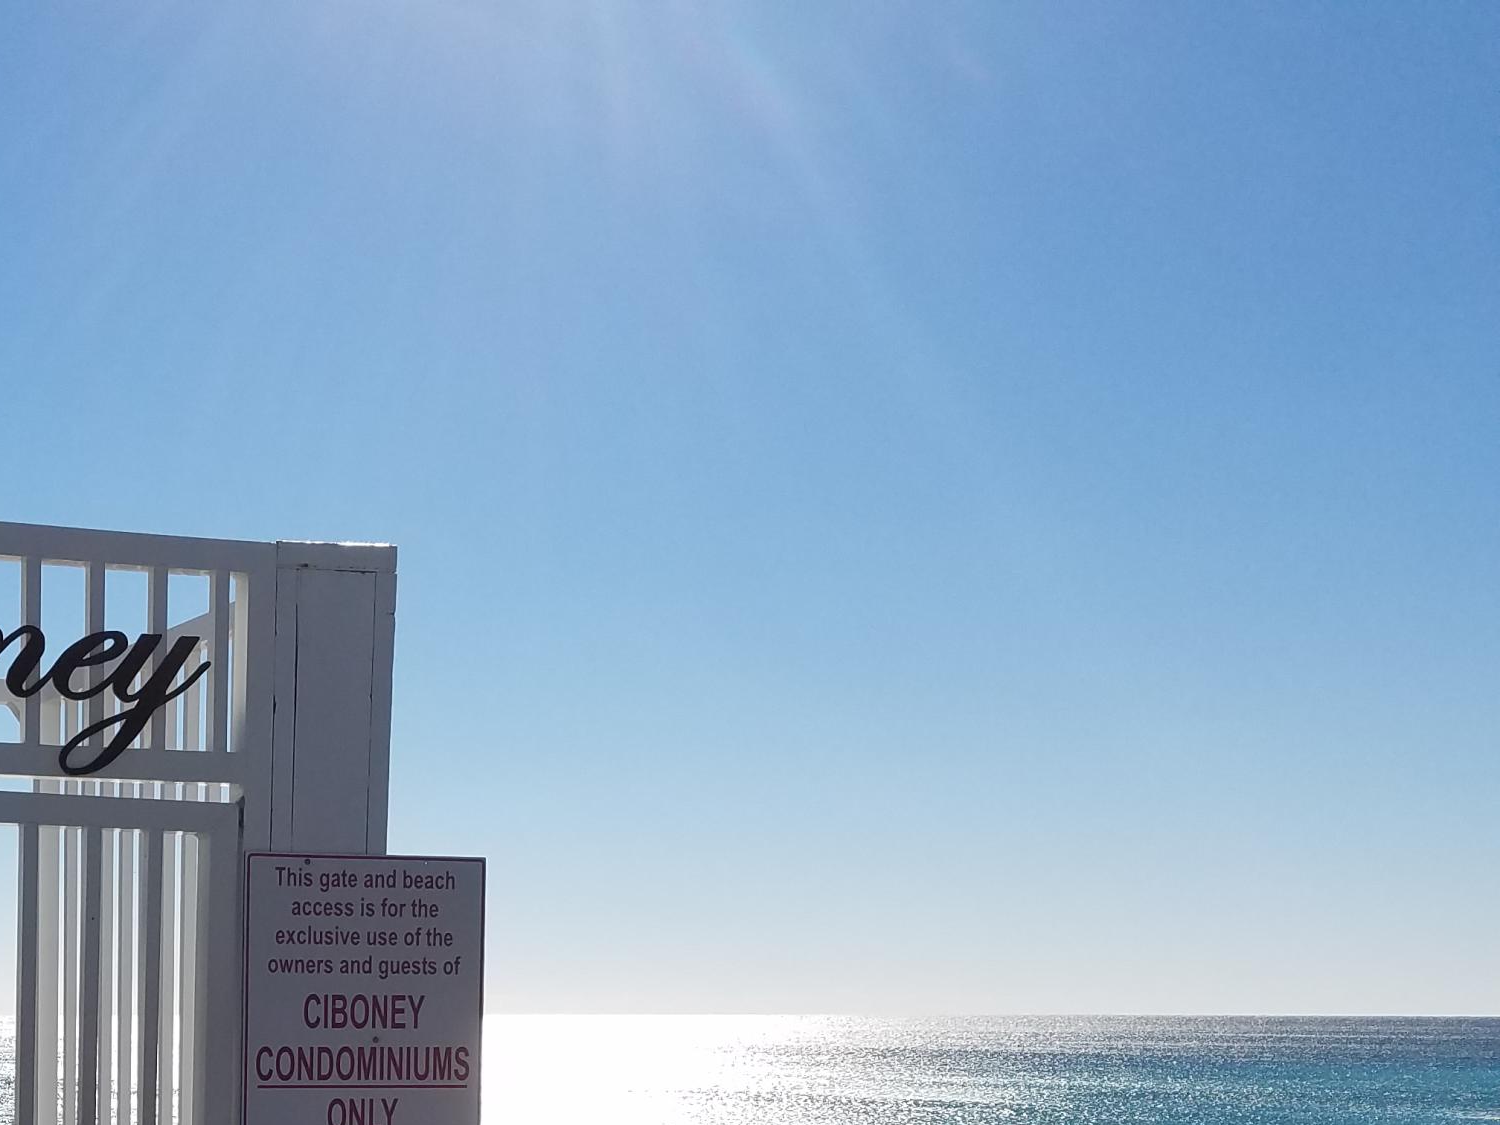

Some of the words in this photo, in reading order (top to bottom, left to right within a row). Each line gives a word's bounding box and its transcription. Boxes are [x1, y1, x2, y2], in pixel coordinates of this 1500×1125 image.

[275, 867, 313, 888] This
[320, 869, 357, 892] gate
[364, 869, 396, 889] and
[403, 869, 455, 890] beach
[291, 899, 354, 916] access
[360, 899, 375, 917] is
[381, 898, 406, 918] for
[411, 899, 439, 918] the
[275, 926, 360, 946] exclusive
[367, 931, 398, 946] use
[404, 927, 422, 946] of
[426, 927, 453, 946] the
[268, 958, 333, 974] owners
[340, 954, 372, 975] and
[379, 956, 437, 980] guests
[443, 956, 460, 975] of
[303, 994, 425, 1029] CIBONEY
[256, 1046, 470, 1082] CONDOMINIUMS
